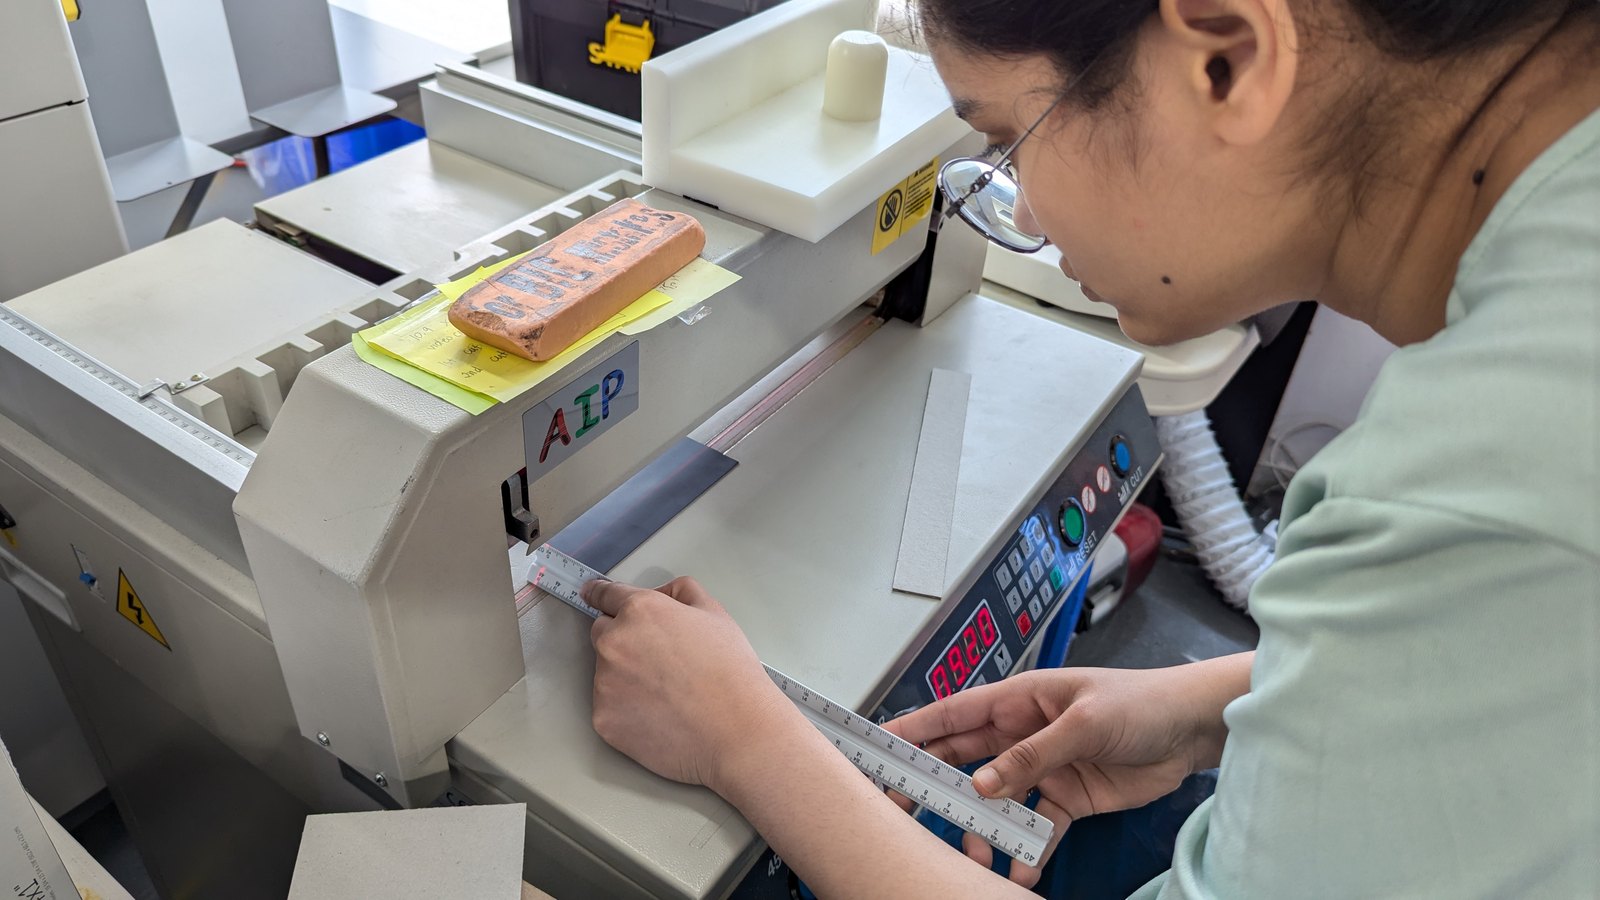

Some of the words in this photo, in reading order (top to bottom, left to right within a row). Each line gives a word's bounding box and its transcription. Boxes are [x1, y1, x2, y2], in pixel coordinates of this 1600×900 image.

[538, 369, 625, 464] AIP
[1129, 466, 1143, 487] CUT
[1075, 530, 1097, 566] RESET
[1001, 807, 1010, 815] 23
[1025, 820, 1035, 829] 24
[768, 854, 782, 877] 45
[1024, 852, 1035, 862] 40
